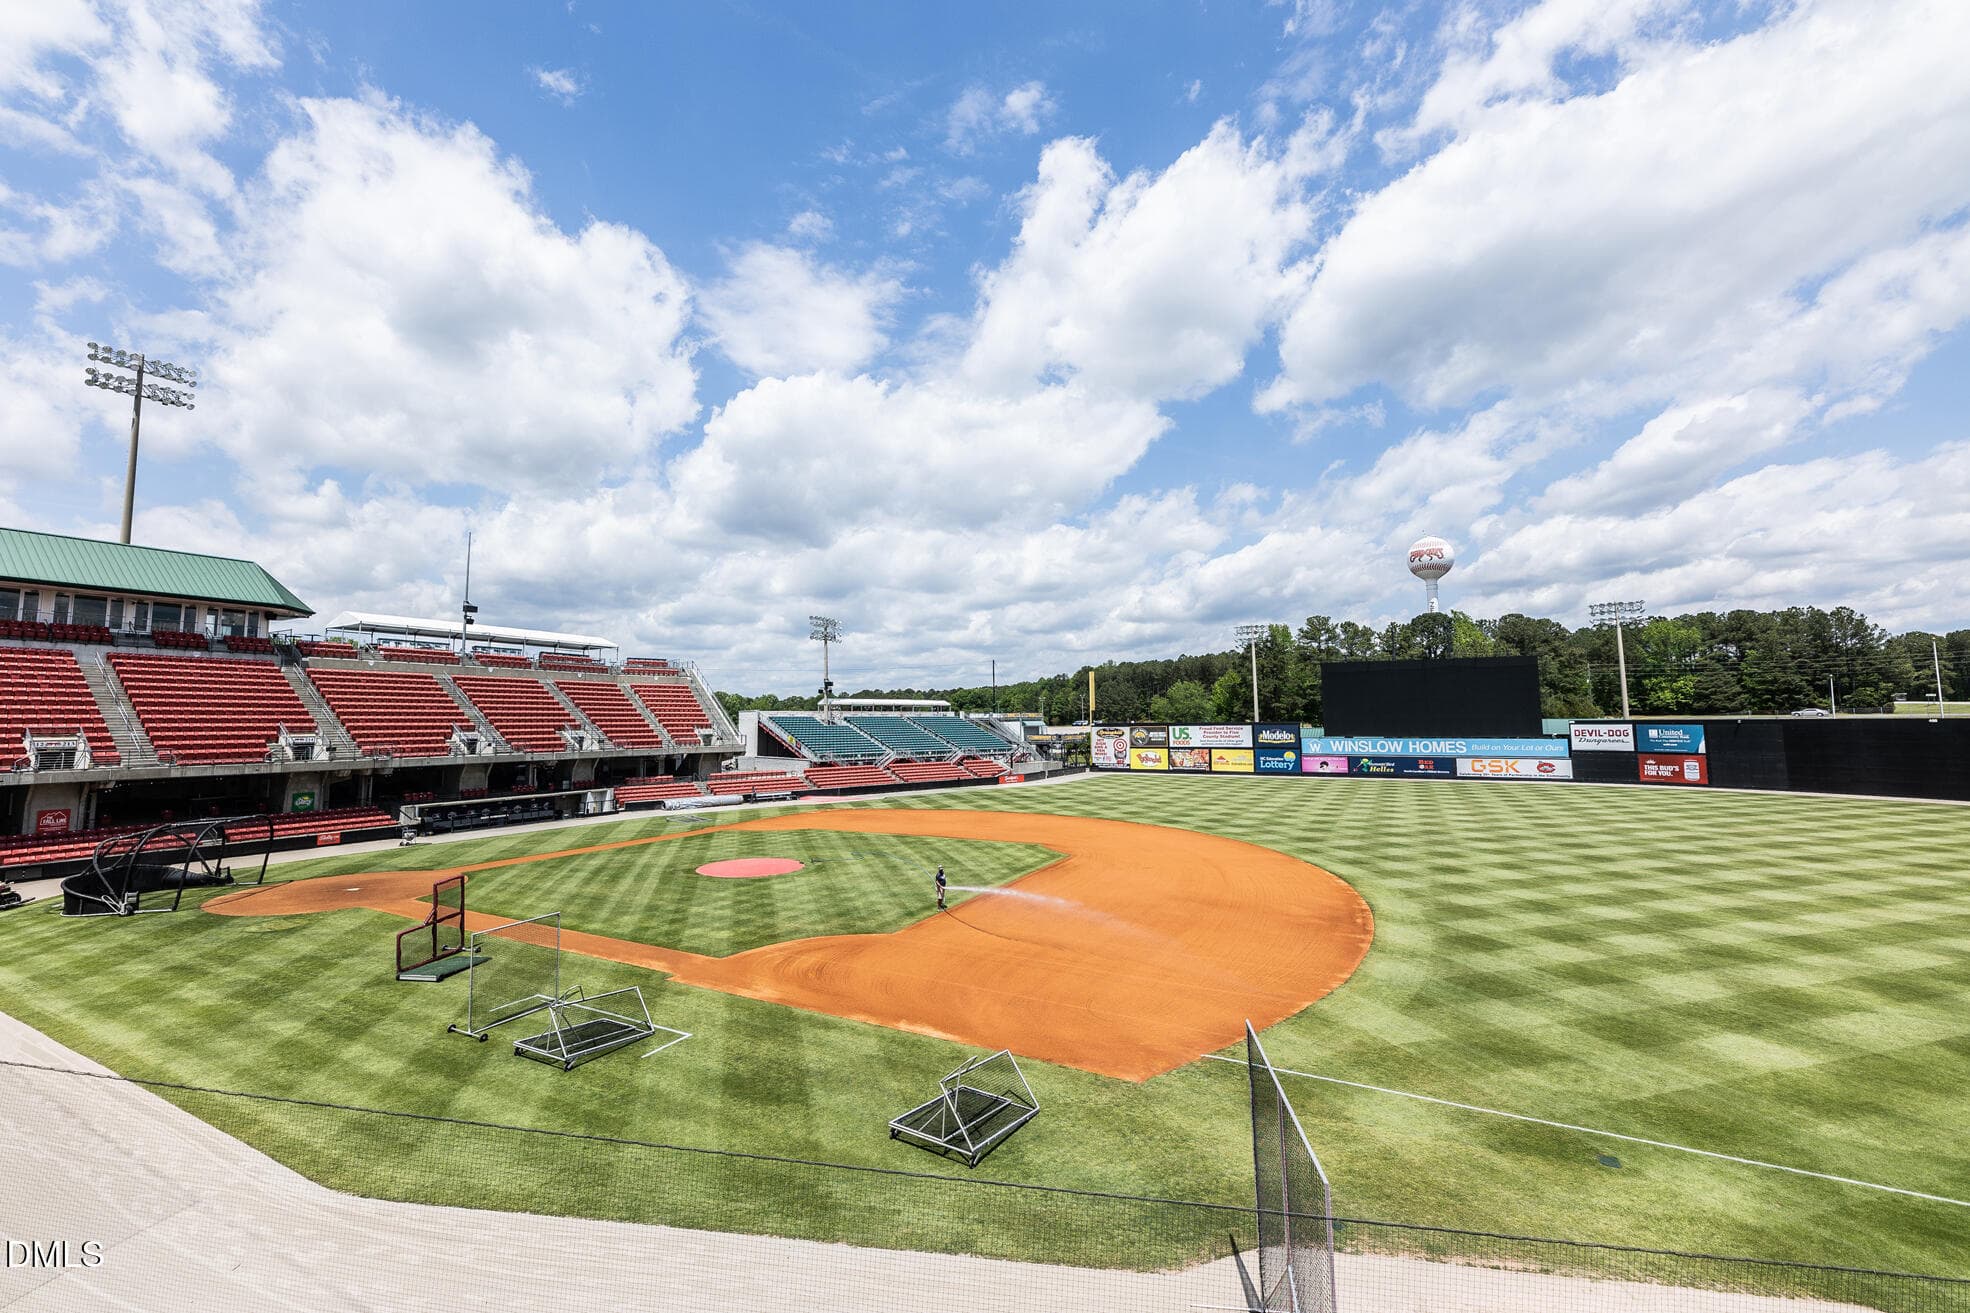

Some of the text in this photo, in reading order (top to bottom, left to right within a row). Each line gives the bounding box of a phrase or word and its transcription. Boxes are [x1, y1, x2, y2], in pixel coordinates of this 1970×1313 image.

[1262, 730, 1291, 740] Modelo
[1574, 729, 1630, 737] DEVIL-DOG
[1658, 728, 1683, 736] United
[1330, 740, 1467, 753] WINSLOW HOMES
[1471, 743, 1490, 751] Build
[1260, 760, 1294, 771] Lottery
[1471, 759, 1520, 773] GSK
[1659, 764, 1680, 772] BUD'S
